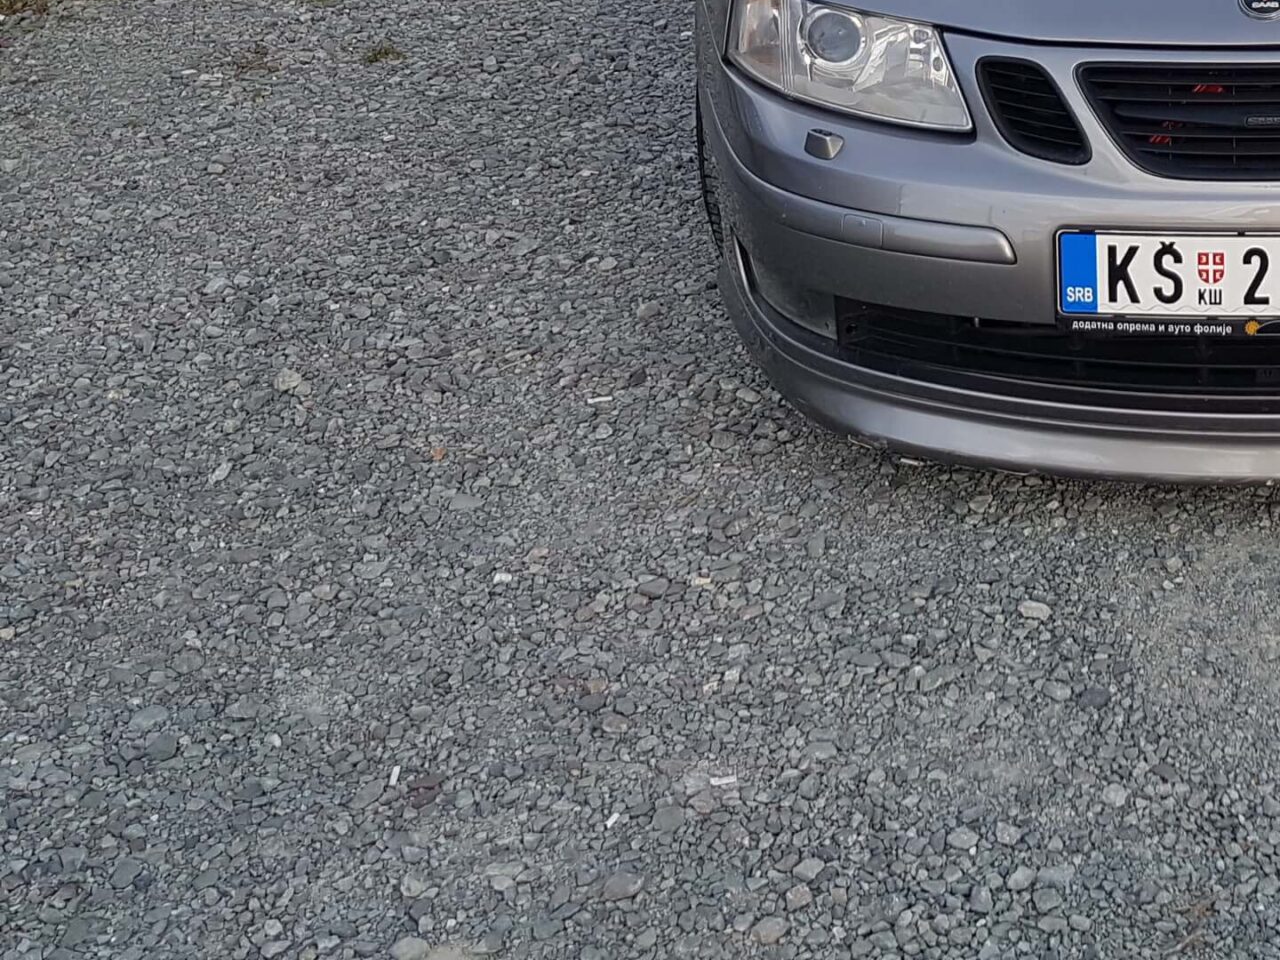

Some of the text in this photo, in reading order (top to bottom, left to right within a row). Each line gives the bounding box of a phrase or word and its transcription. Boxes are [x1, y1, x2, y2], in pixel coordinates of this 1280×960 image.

[1107, 241, 1184, 304] KŠ
[1066, 286, 1093, 302] SRB
[1072, 320, 1232, 335] додатна опрема и ауто фолије
